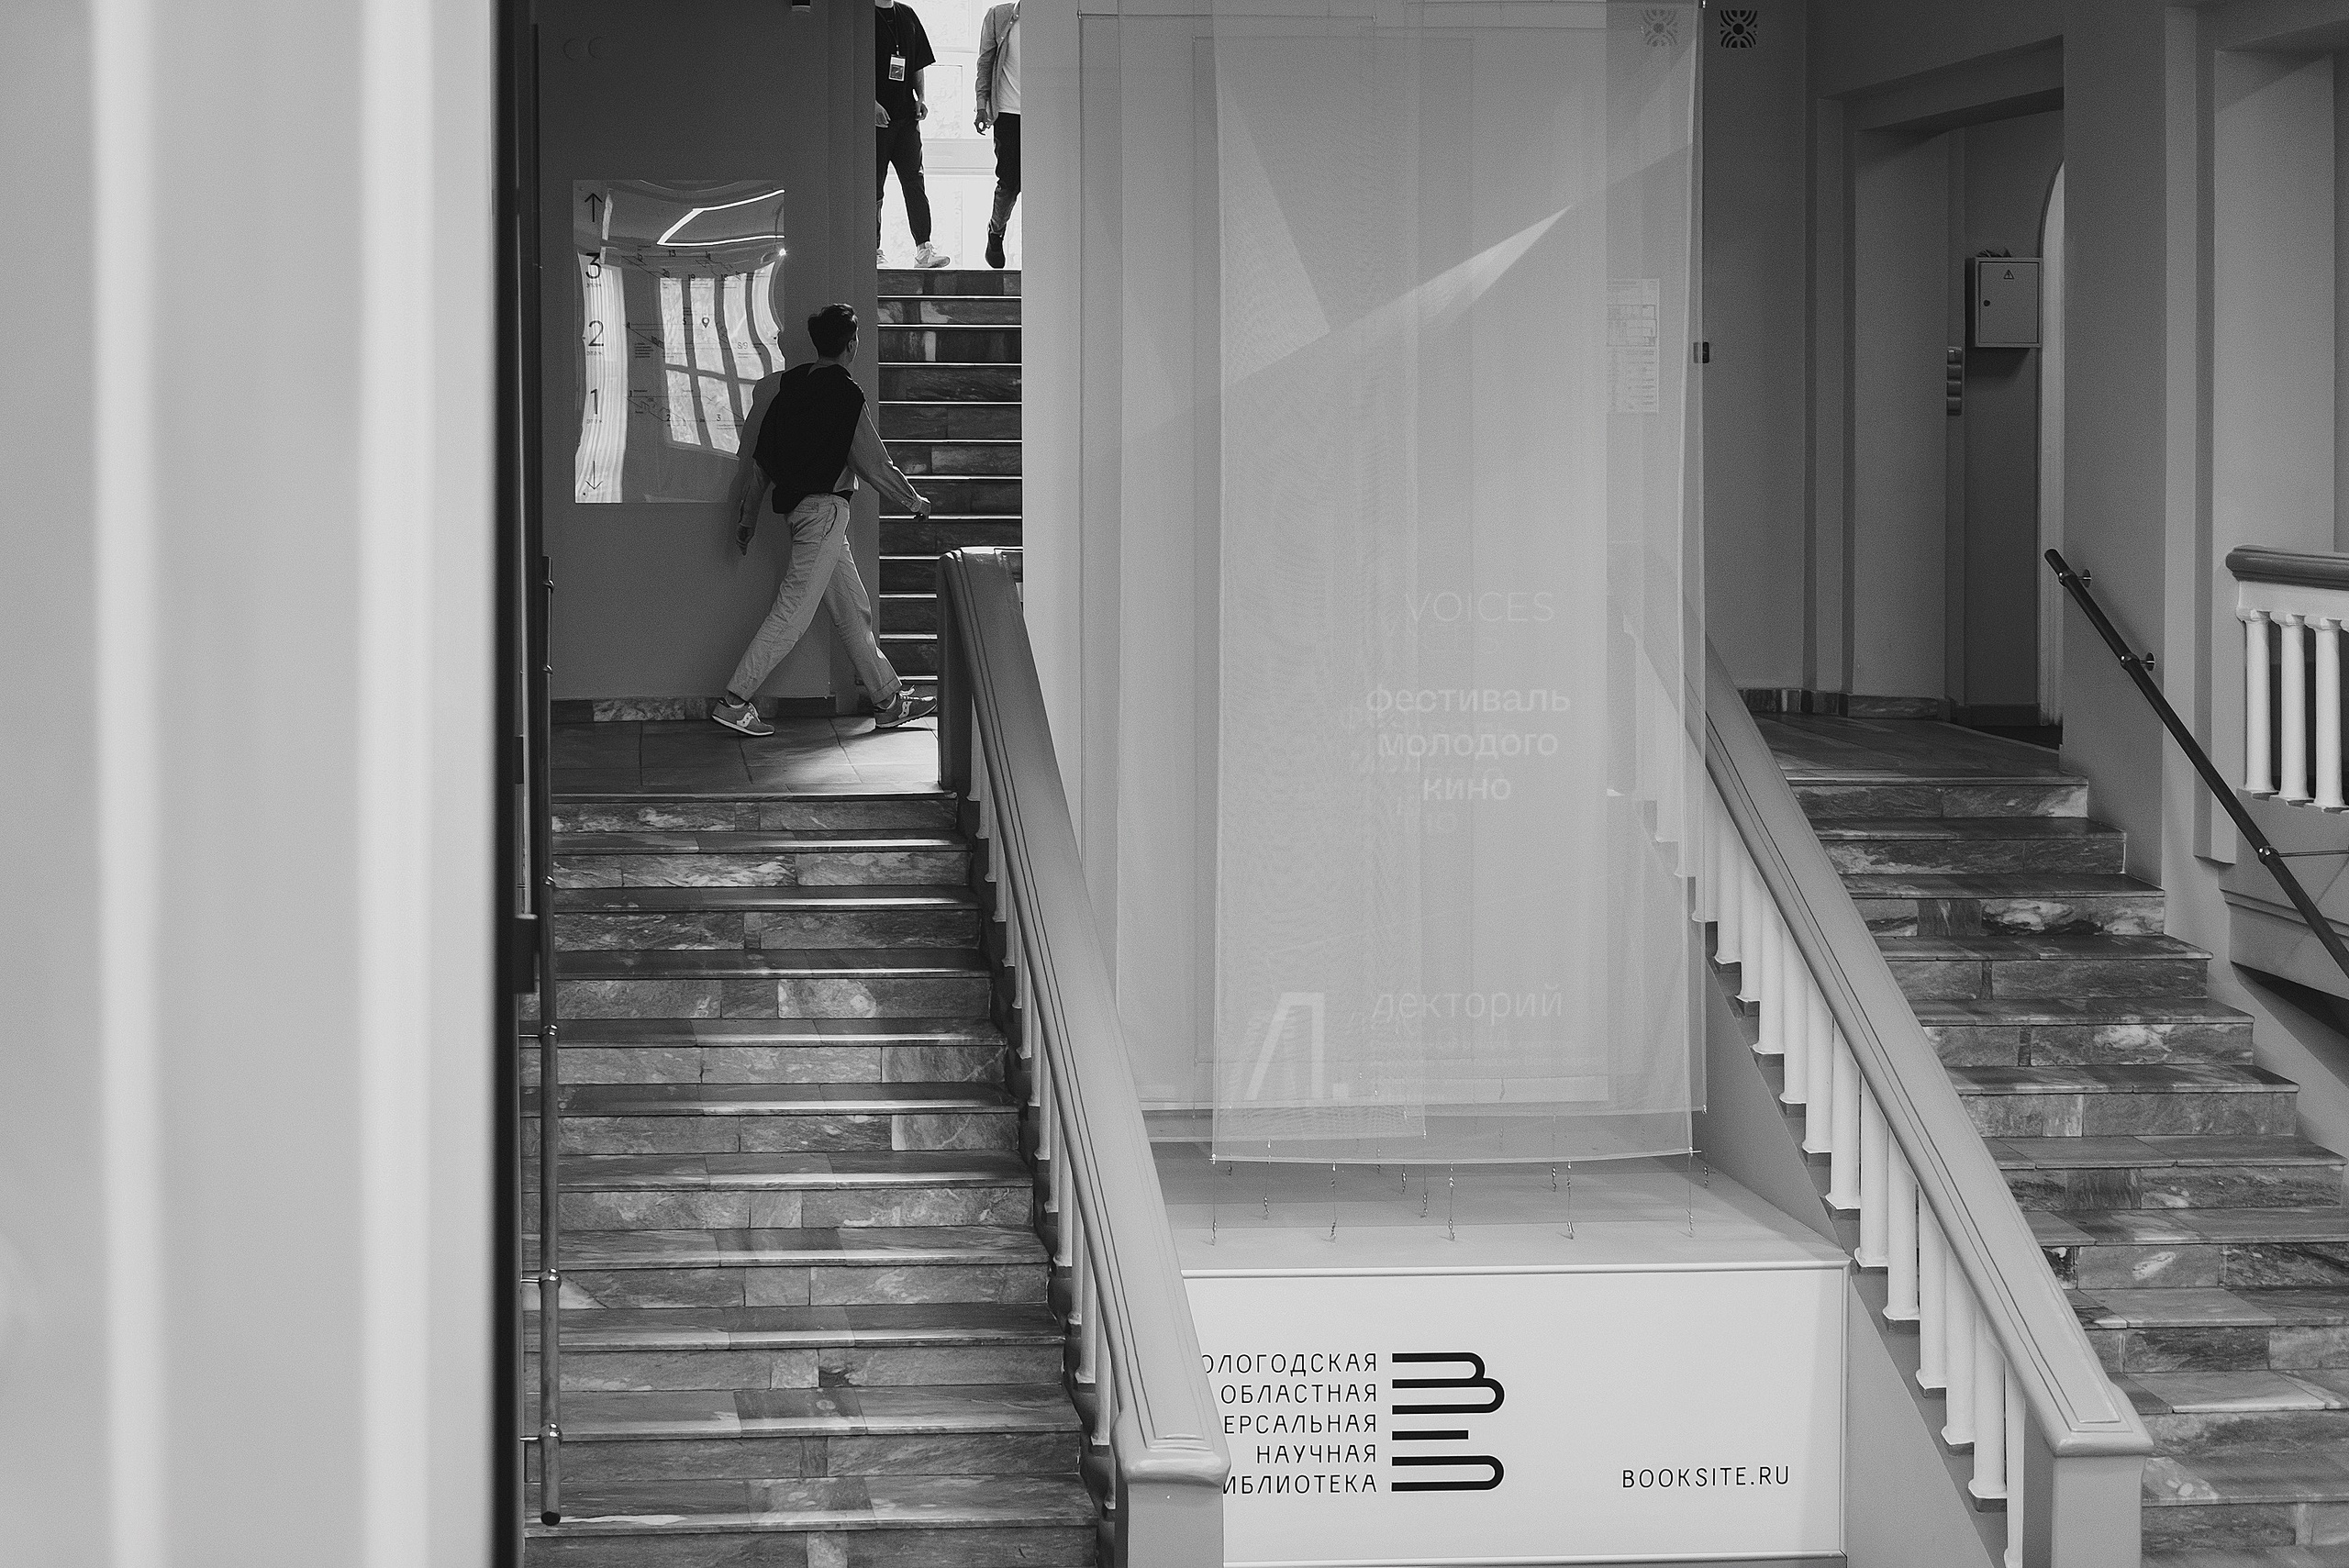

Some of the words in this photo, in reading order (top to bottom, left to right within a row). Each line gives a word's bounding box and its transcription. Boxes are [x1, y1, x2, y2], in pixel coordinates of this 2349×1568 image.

[585, 251, 602, 279] 3
[588, 319, 605, 347] 2
[590, 387, 598, 416] 1
[1404, 591, 1556, 624] VOICES
[1365, 683, 1572, 719] фестиваль
[1377, 732, 1560, 761] молодого
[1422, 777, 1512, 802] кино
[1371, 983, 1564, 1026] лекторий
[1202, 1352, 1376, 1377] ОЛОГОДСКАЯ
[1220, 1384, 1376, 1405] ОБЛАСТНАЯ
[1224, 1414, 1376, 1434] ЕРСАЛЬНАЯ
[1256, 1443, 1376, 1464] НАУЧНАЯ
[1223, 1473, 1377, 1495] ИБЛИОТЕКА
[1621, 1465, 1789, 1488] BOOKSITE.RU
